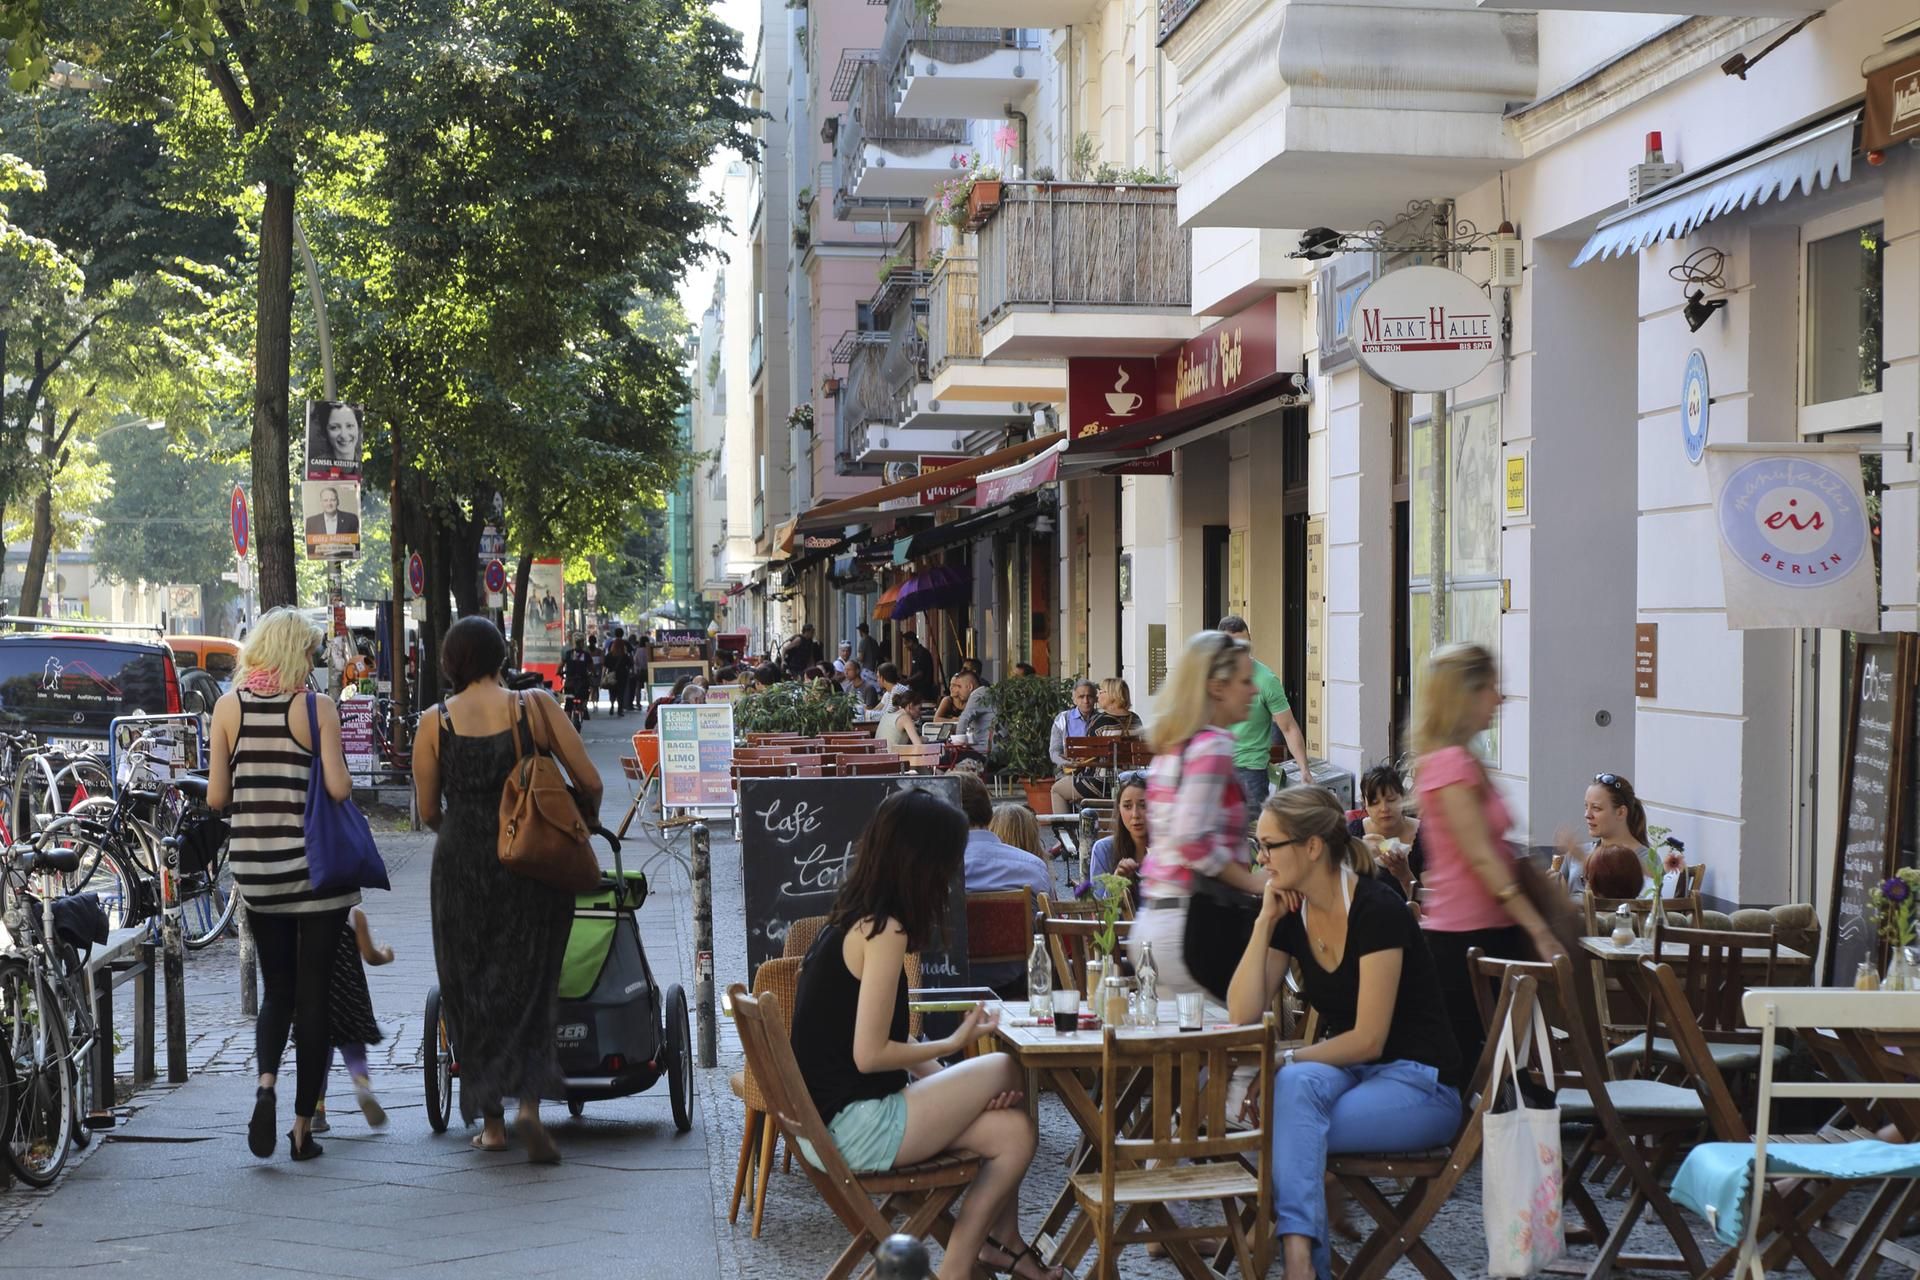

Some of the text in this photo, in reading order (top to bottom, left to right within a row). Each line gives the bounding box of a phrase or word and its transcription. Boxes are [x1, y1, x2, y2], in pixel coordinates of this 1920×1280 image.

[1362, 306, 1488, 342] MARKTHALLE
[1364, 341, 1491, 352] VON FRÜH BIS SPÄT
[310, 458, 359, 468] CANSEL KIZILTEPE
[1735, 462, 1850, 514] manufaktur
[1764, 498, 1825, 531] eis
[1760, 552, 1842, 575] BERLIN
[53, 692, 71, 700] Planung
[76, 693, 101, 701] Ausführung
[667, 753, 695, 762] LIMO
[755, 799, 824, 843] Café
